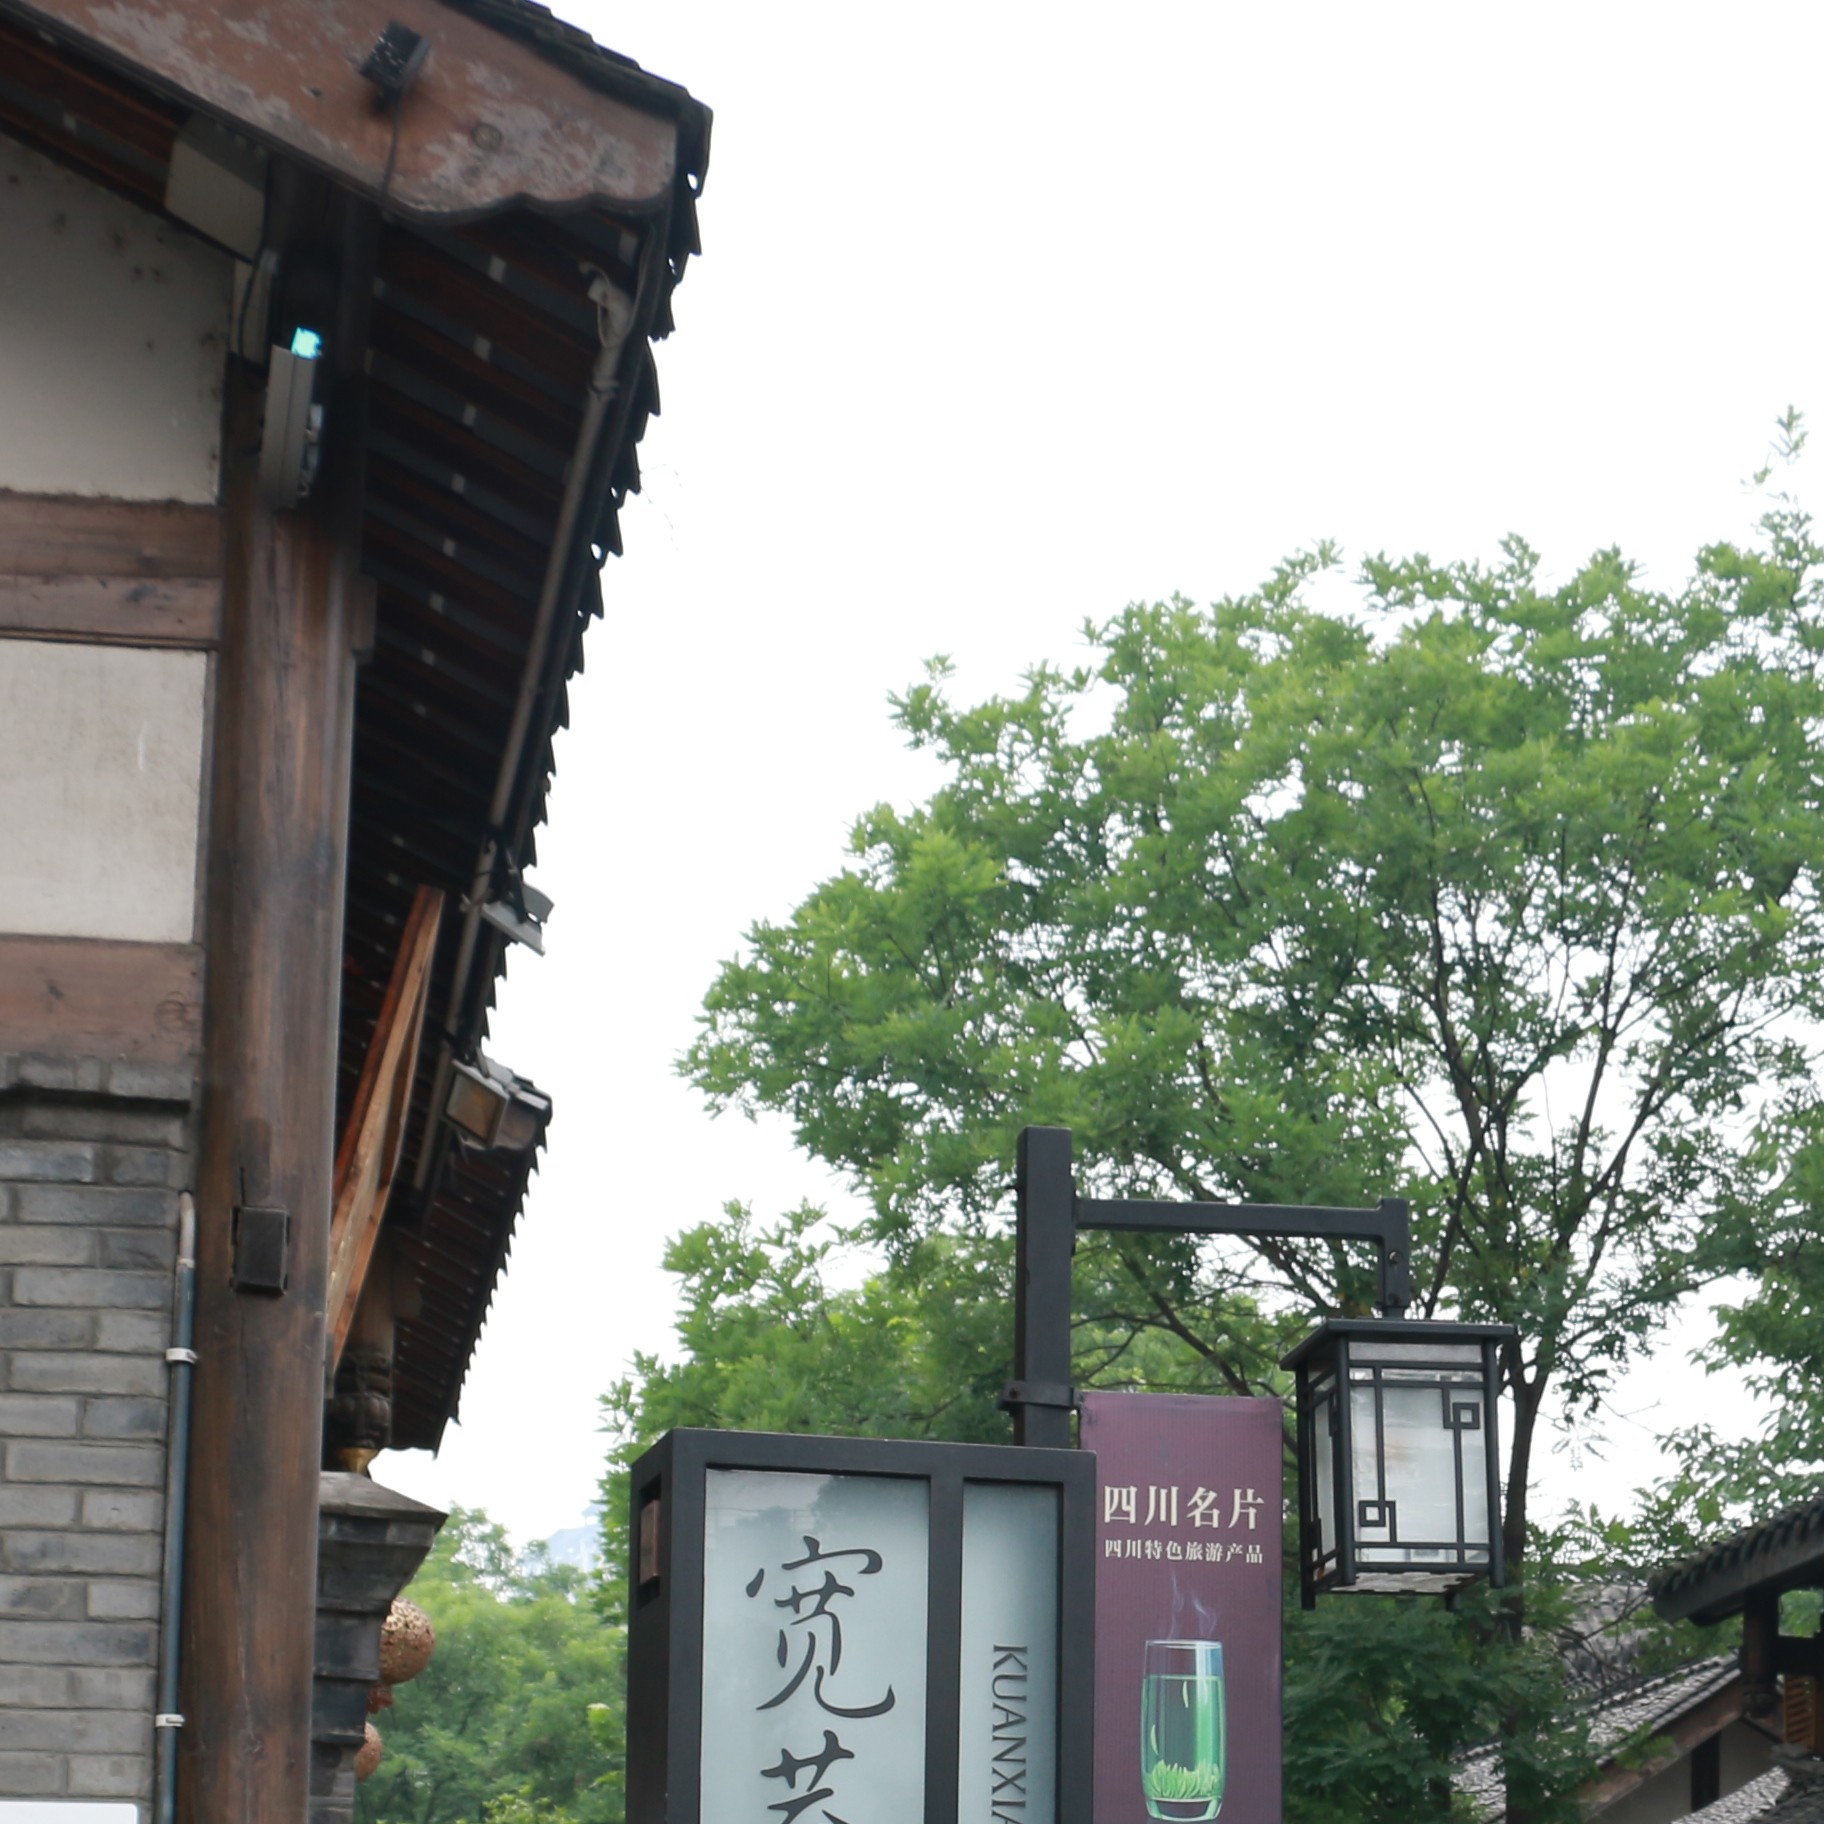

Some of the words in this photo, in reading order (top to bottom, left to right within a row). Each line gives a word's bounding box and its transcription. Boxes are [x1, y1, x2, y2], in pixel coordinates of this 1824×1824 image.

[1104, 1485, 1265, 1530] 四川名片
[1105, 1539, 1263, 1564] 四川特色旅游产品
